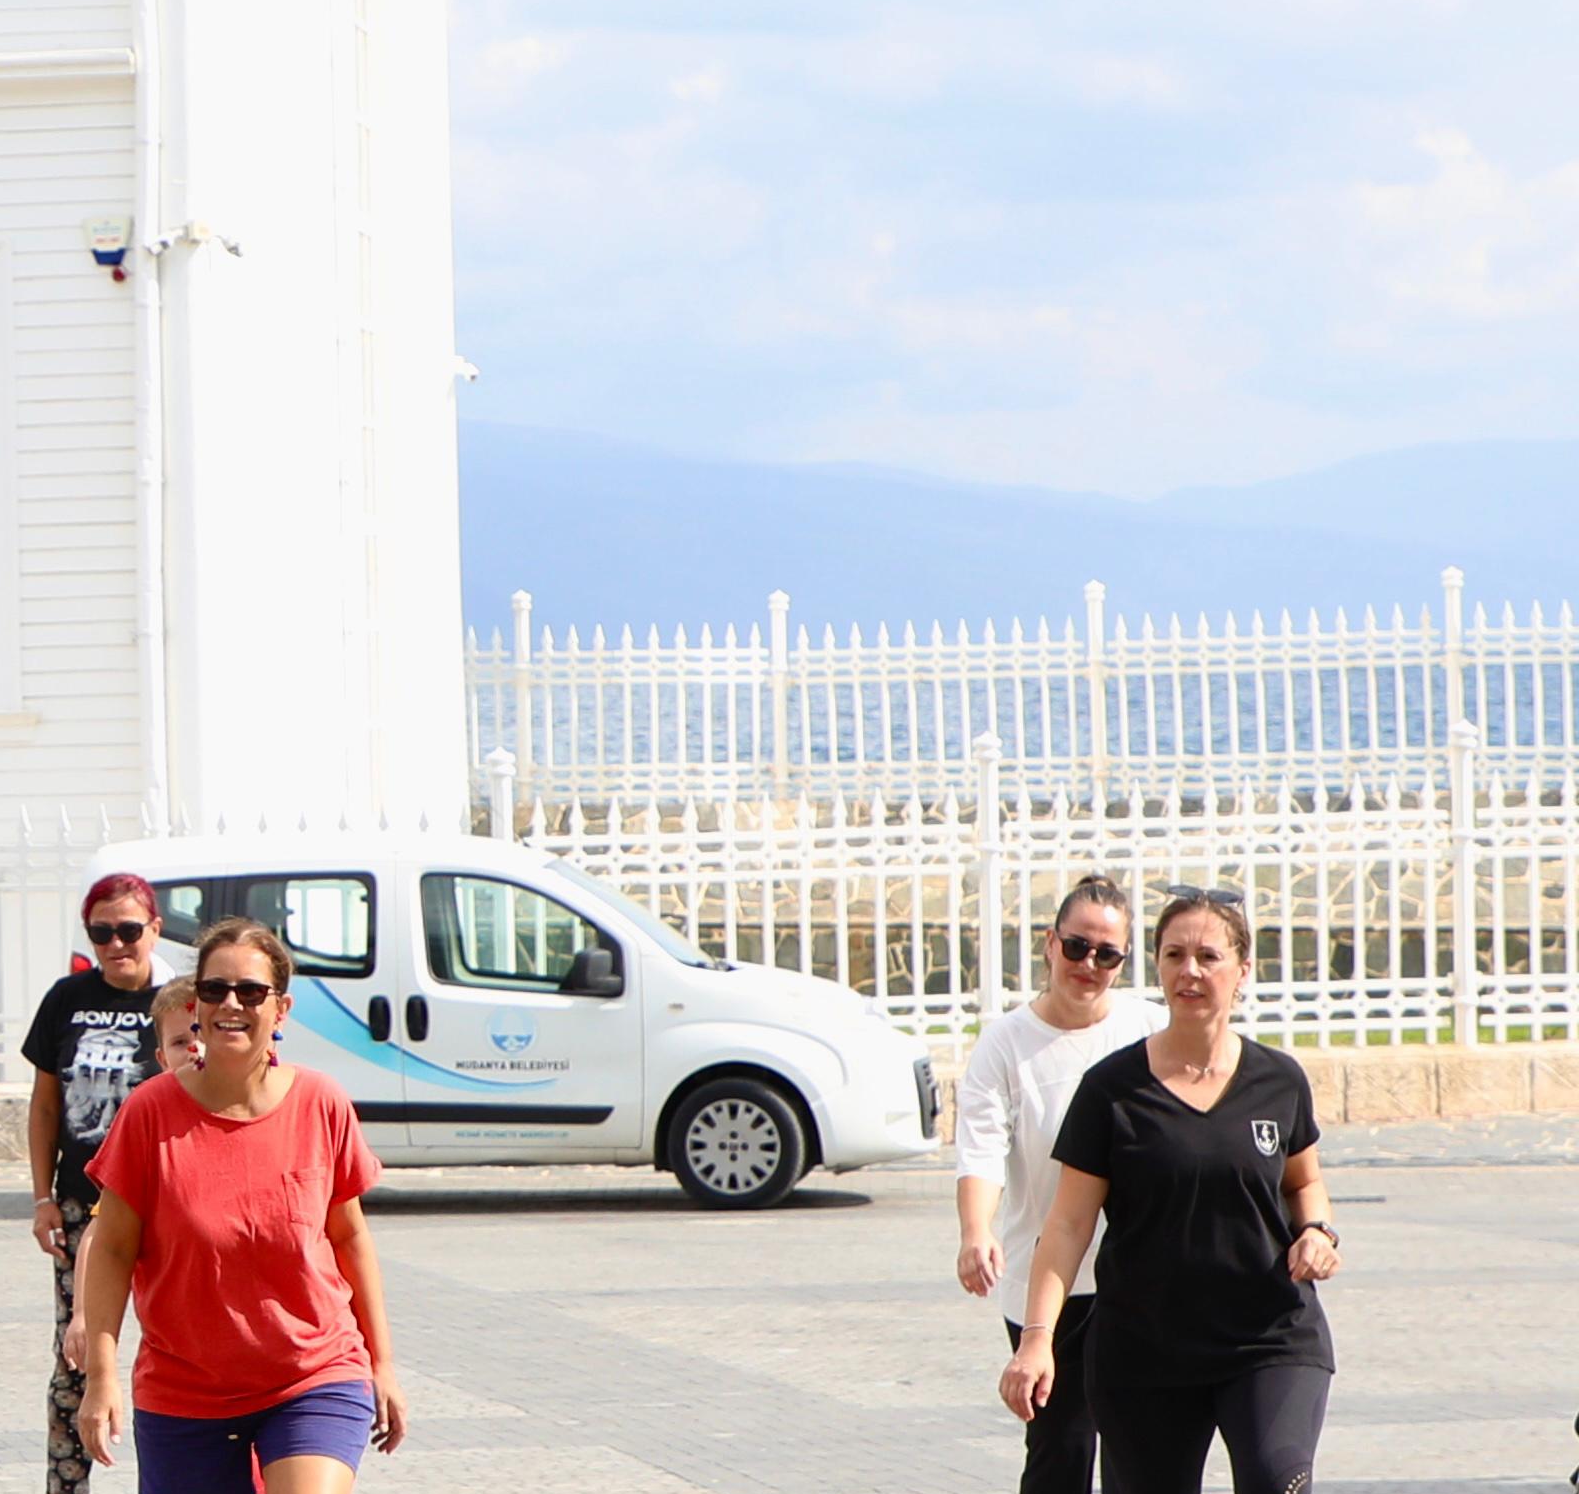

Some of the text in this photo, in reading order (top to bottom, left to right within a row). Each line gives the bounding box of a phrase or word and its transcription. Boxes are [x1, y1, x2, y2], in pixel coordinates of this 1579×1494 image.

[70, 1010, 154, 1032] BON JOV
[455, 1059, 571, 1071] MUDANYA BELEDİYESİ
